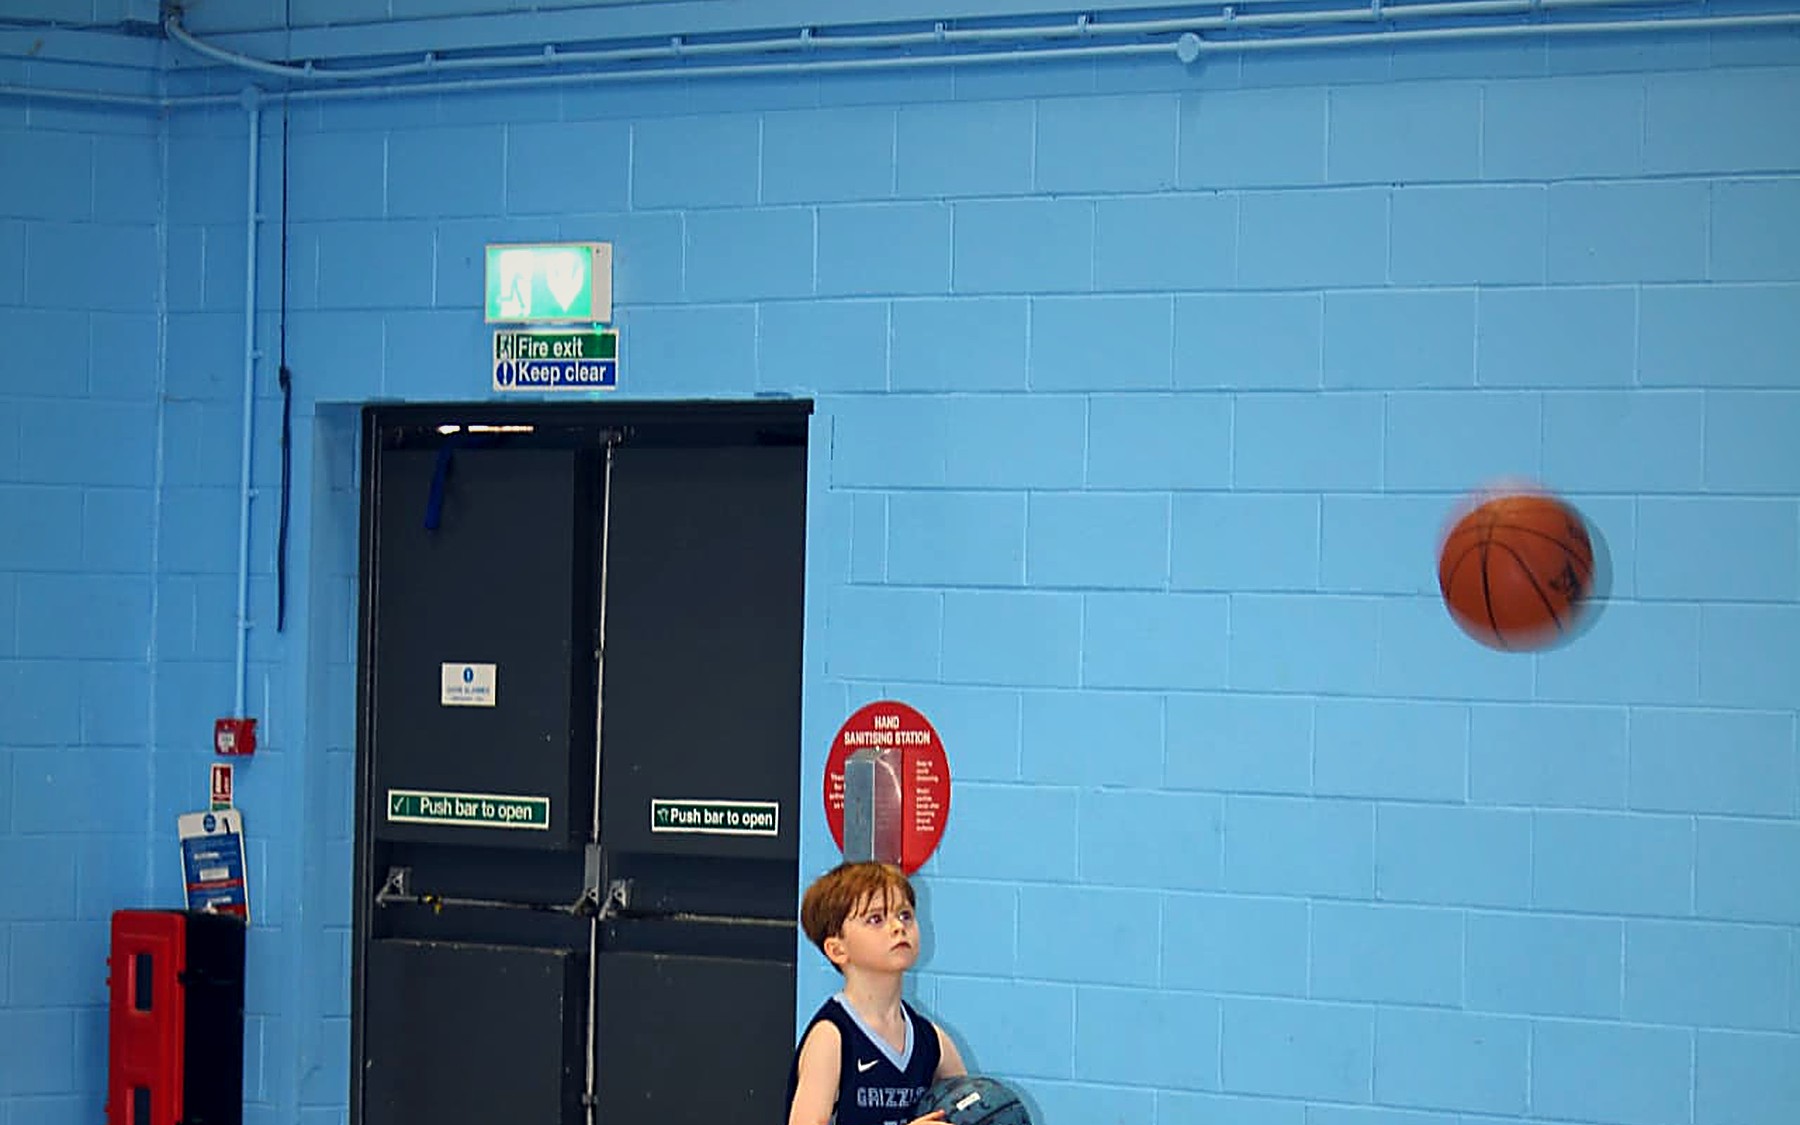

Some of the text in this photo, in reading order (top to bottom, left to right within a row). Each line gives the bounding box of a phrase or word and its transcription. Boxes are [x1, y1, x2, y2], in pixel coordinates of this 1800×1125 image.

[518, 335, 583, 357] Fire exit
[518, 361, 606, 386] Keep clear
[874, 715, 900, 730] HAND
[844, 731, 931, 746] SANITISING STATION
[420, 797, 533, 822] Push bar to open
[670, 807, 773, 829] Push bar to open
